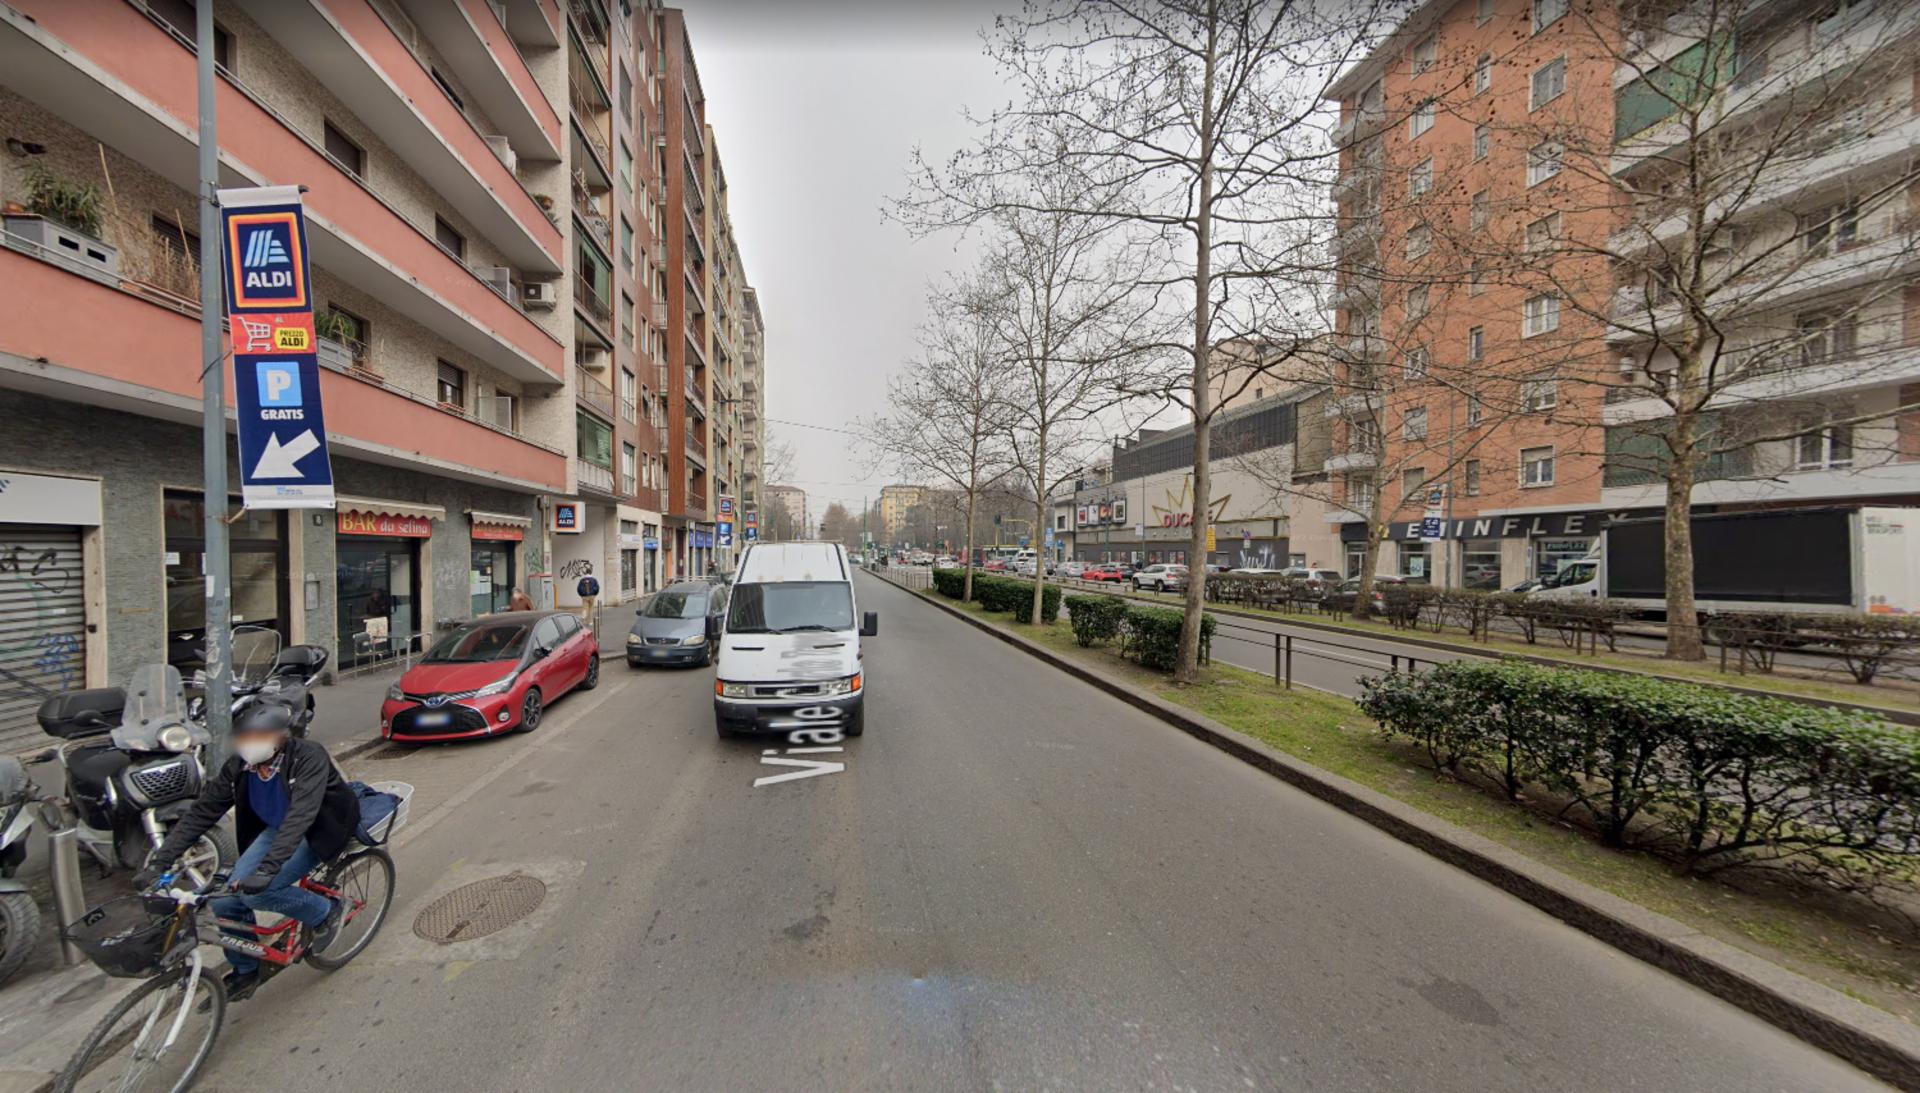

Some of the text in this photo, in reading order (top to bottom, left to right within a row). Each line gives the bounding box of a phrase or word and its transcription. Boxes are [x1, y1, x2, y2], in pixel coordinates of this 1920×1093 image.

[246, 271, 293, 288] ALDI
[279, 329, 304, 337] PREZZO
[280, 337, 304, 347] ALDI
[267, 369, 291, 401] P
[261, 409, 304, 420] GRATIS
[342, 512, 376, 532] BAR
[381, 519, 395, 532] da
